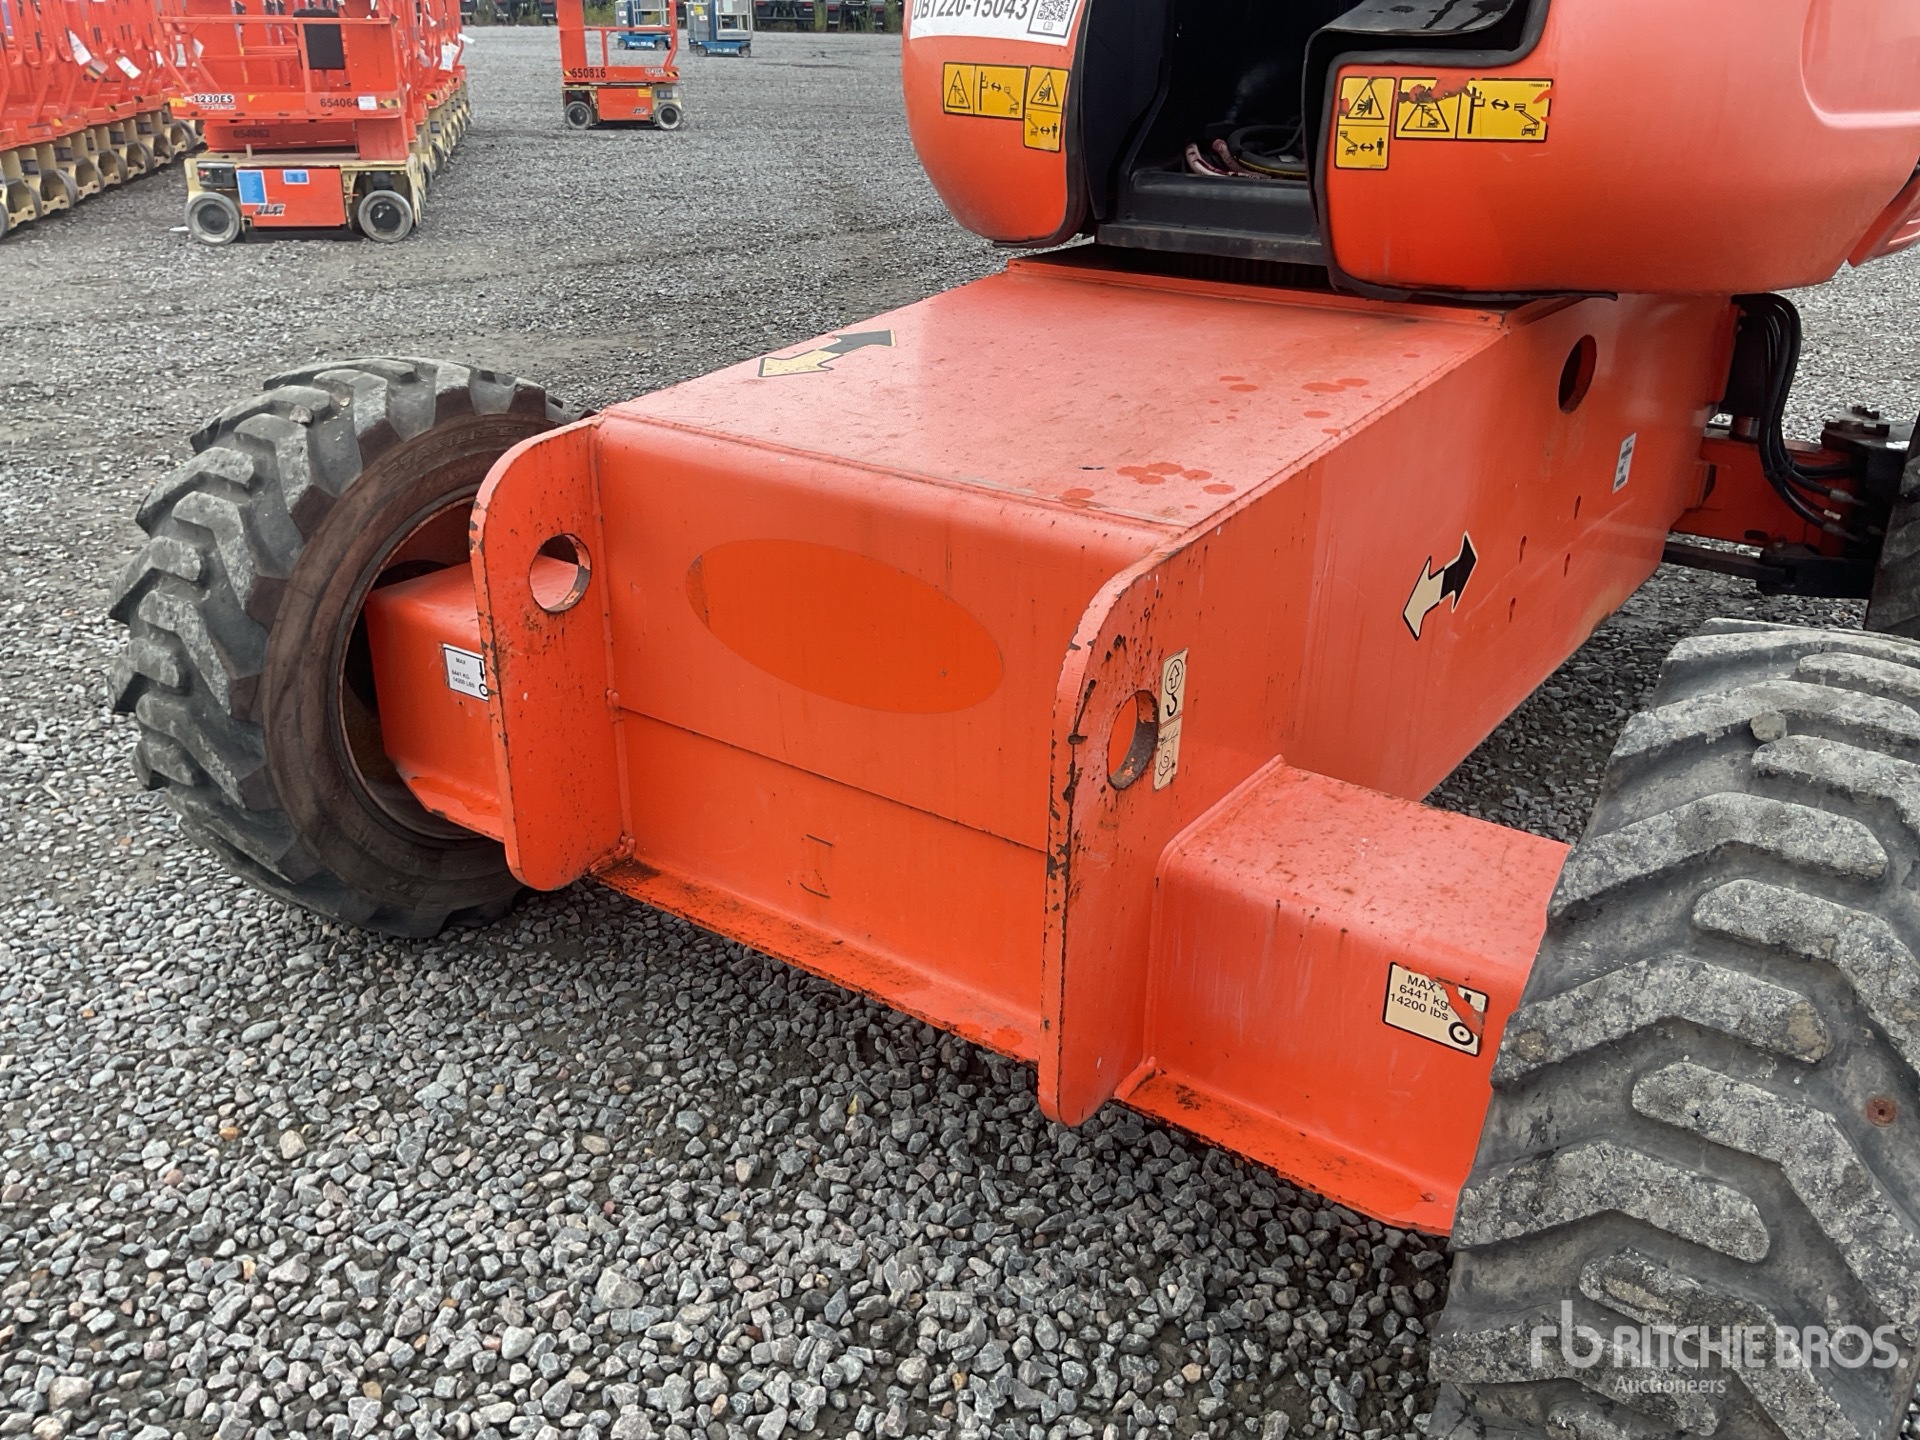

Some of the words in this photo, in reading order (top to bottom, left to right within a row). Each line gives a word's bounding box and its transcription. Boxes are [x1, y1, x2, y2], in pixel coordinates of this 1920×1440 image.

[571, 67, 606, 78] 650816
[194, 94, 233, 104] 1230ES
[320, 98, 359, 108] 654064
[256, 204, 286, 215] JLG
[1407, 975, 1436, 993] MAX
[1400, 984, 1428, 1001] 6441
[1433, 995, 1448, 1010] kg
[1391, 993, 1426, 1013] 14200
[1430, 1007, 1449, 1021] lbs
